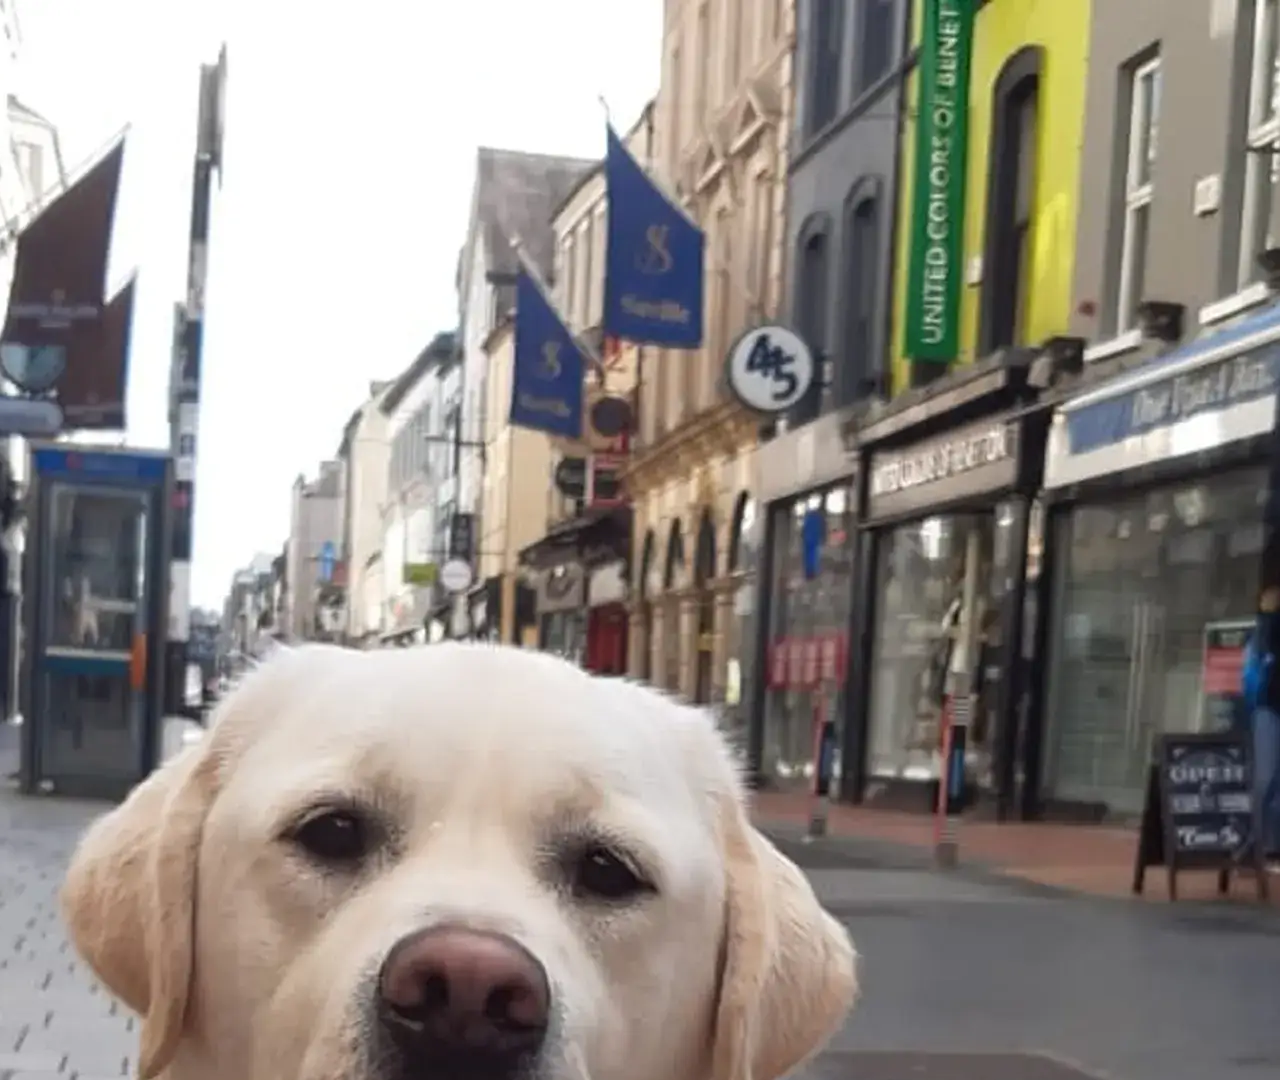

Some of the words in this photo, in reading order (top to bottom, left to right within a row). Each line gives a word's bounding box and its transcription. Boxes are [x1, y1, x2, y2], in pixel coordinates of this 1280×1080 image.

[932, 92, 955, 128] OF
[926, 136, 953, 240] COLORS
[920, 248, 949, 344] UNITED
